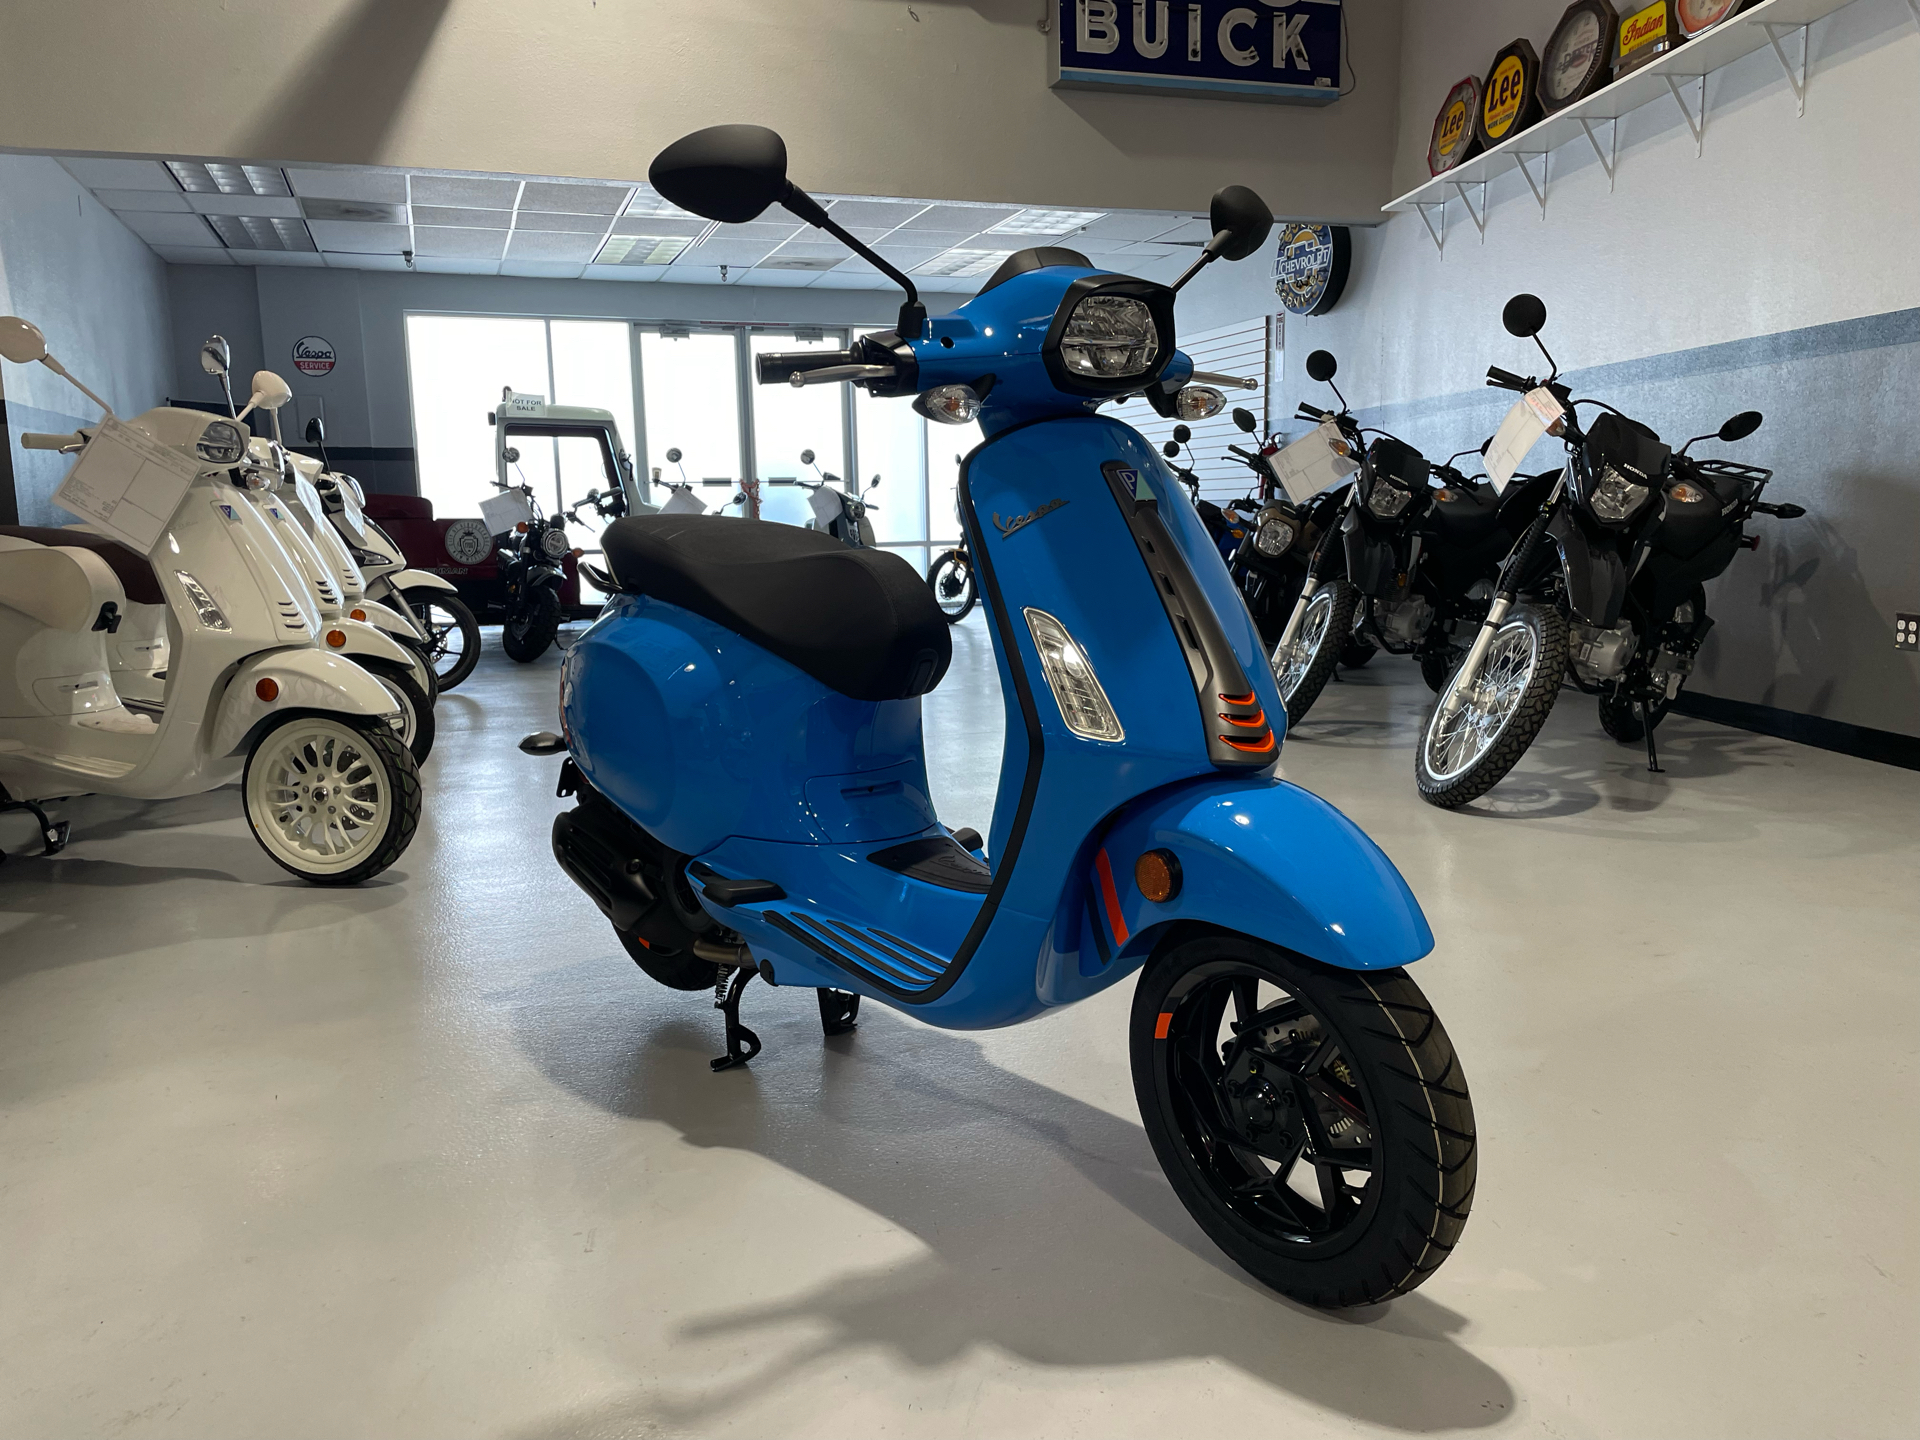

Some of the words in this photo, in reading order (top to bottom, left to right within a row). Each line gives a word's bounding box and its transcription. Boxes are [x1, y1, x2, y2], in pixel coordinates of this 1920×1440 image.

[1076, 0, 1311, 71] BUICK
[1622, 13, 1665, 46] Indian
[1487, 69, 1521, 113] Lee
[1441, 110, 1464, 138] Lee
[1280, 249, 1329, 274] CHEVROLET
[295, 340, 334, 360] Vespa
[299, 361, 331, 370] SERVICE
[1623, 462, 1648, 480] HONDA
[992, 498, 1071, 540] Vespa
